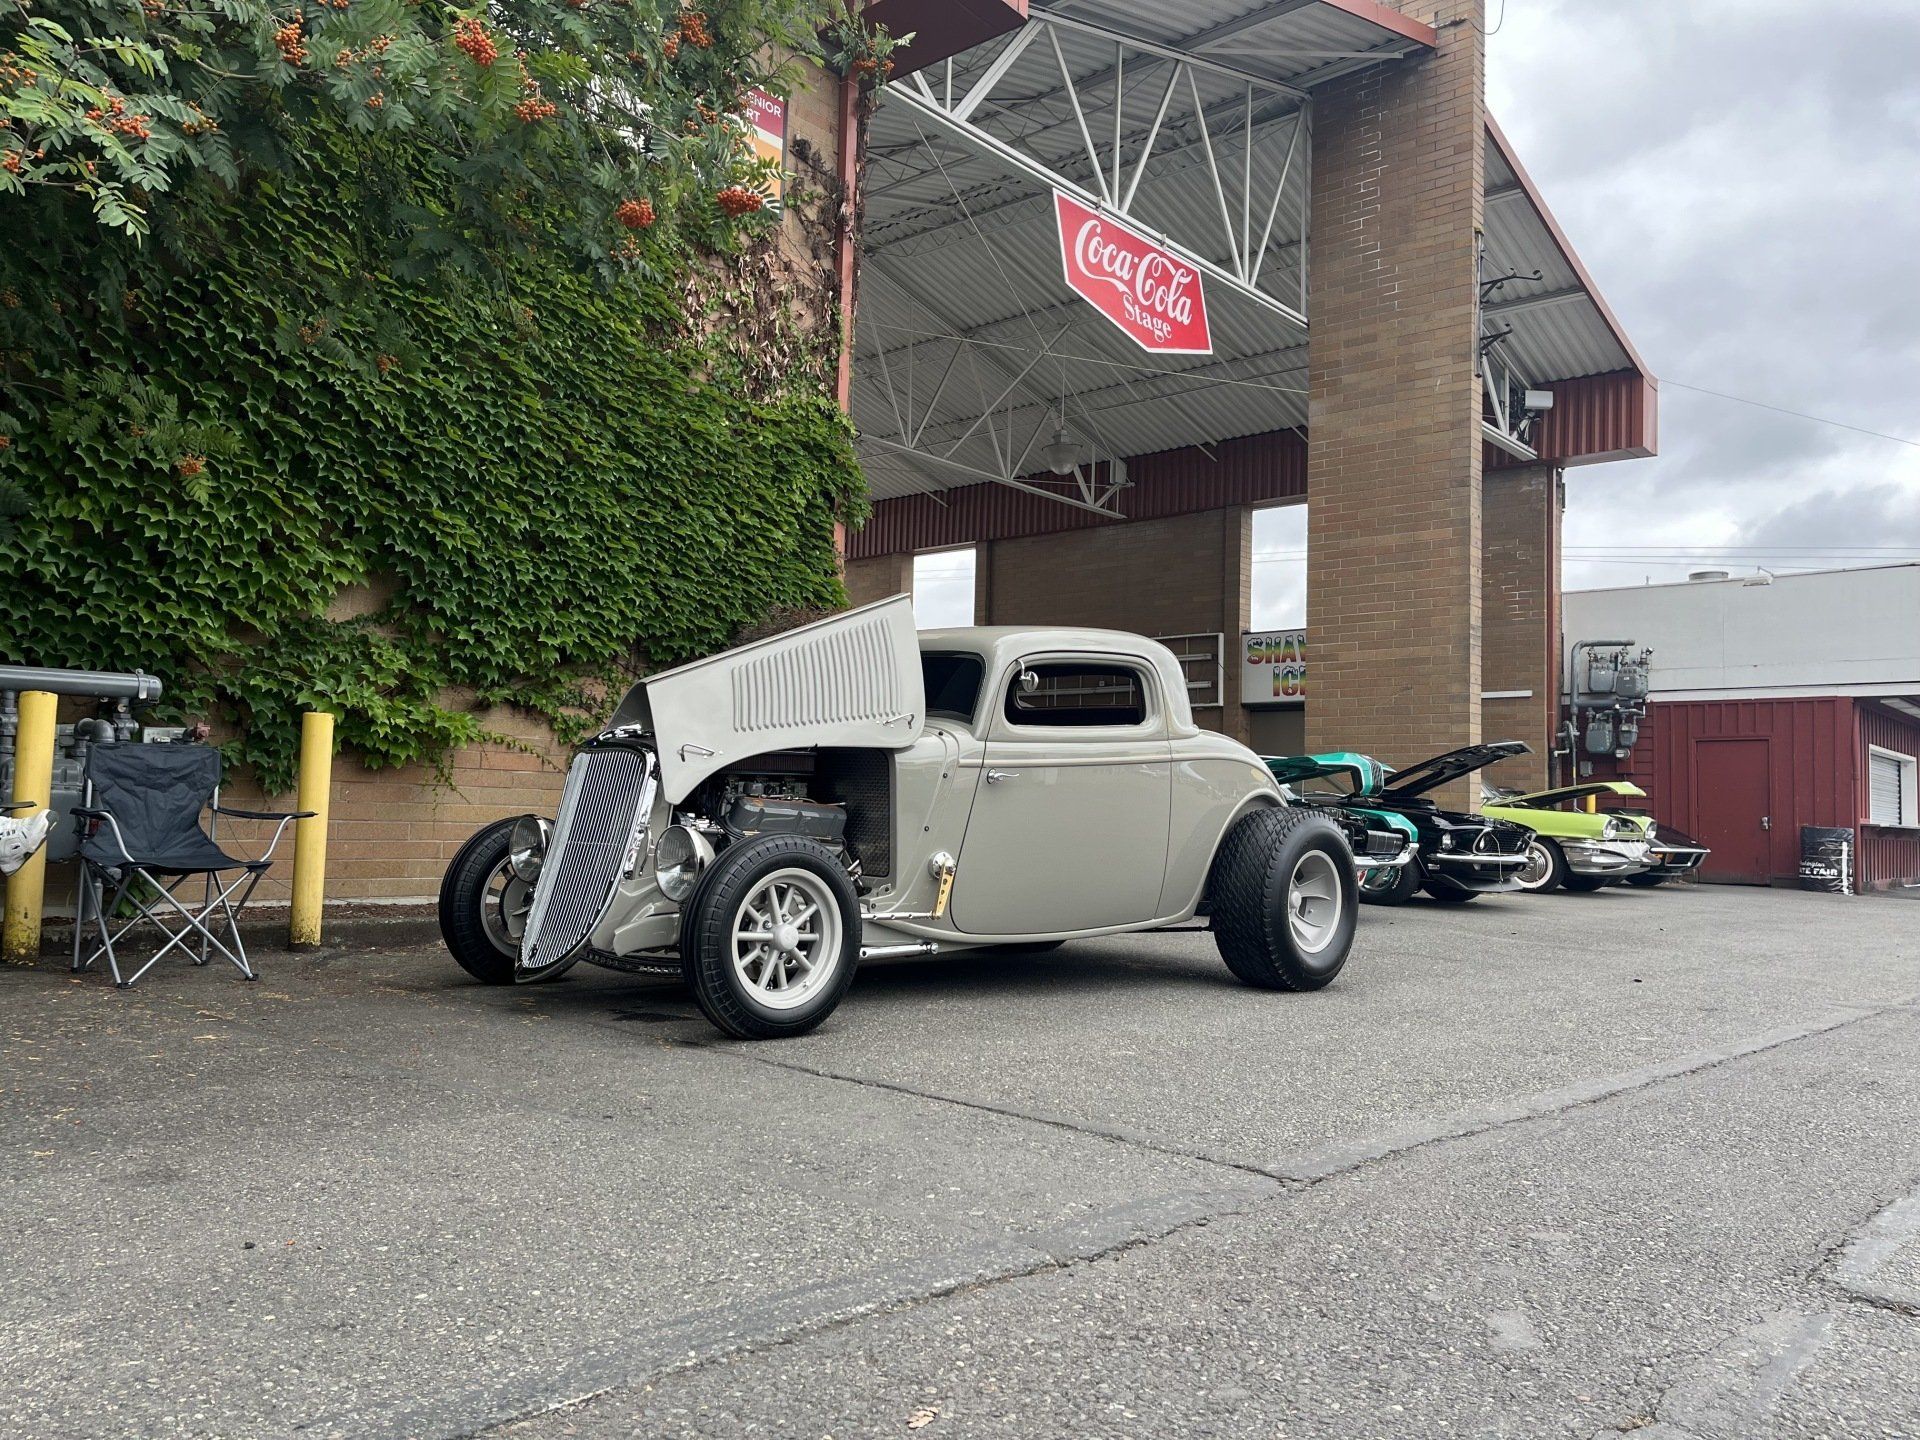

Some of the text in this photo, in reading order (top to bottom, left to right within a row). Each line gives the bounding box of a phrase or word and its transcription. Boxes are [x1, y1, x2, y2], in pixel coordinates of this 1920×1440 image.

[1075, 219, 1193, 326] Coca-Cola
[1123, 293, 1173, 343] Stage
[1813, 867, 1838, 876] FAIR
